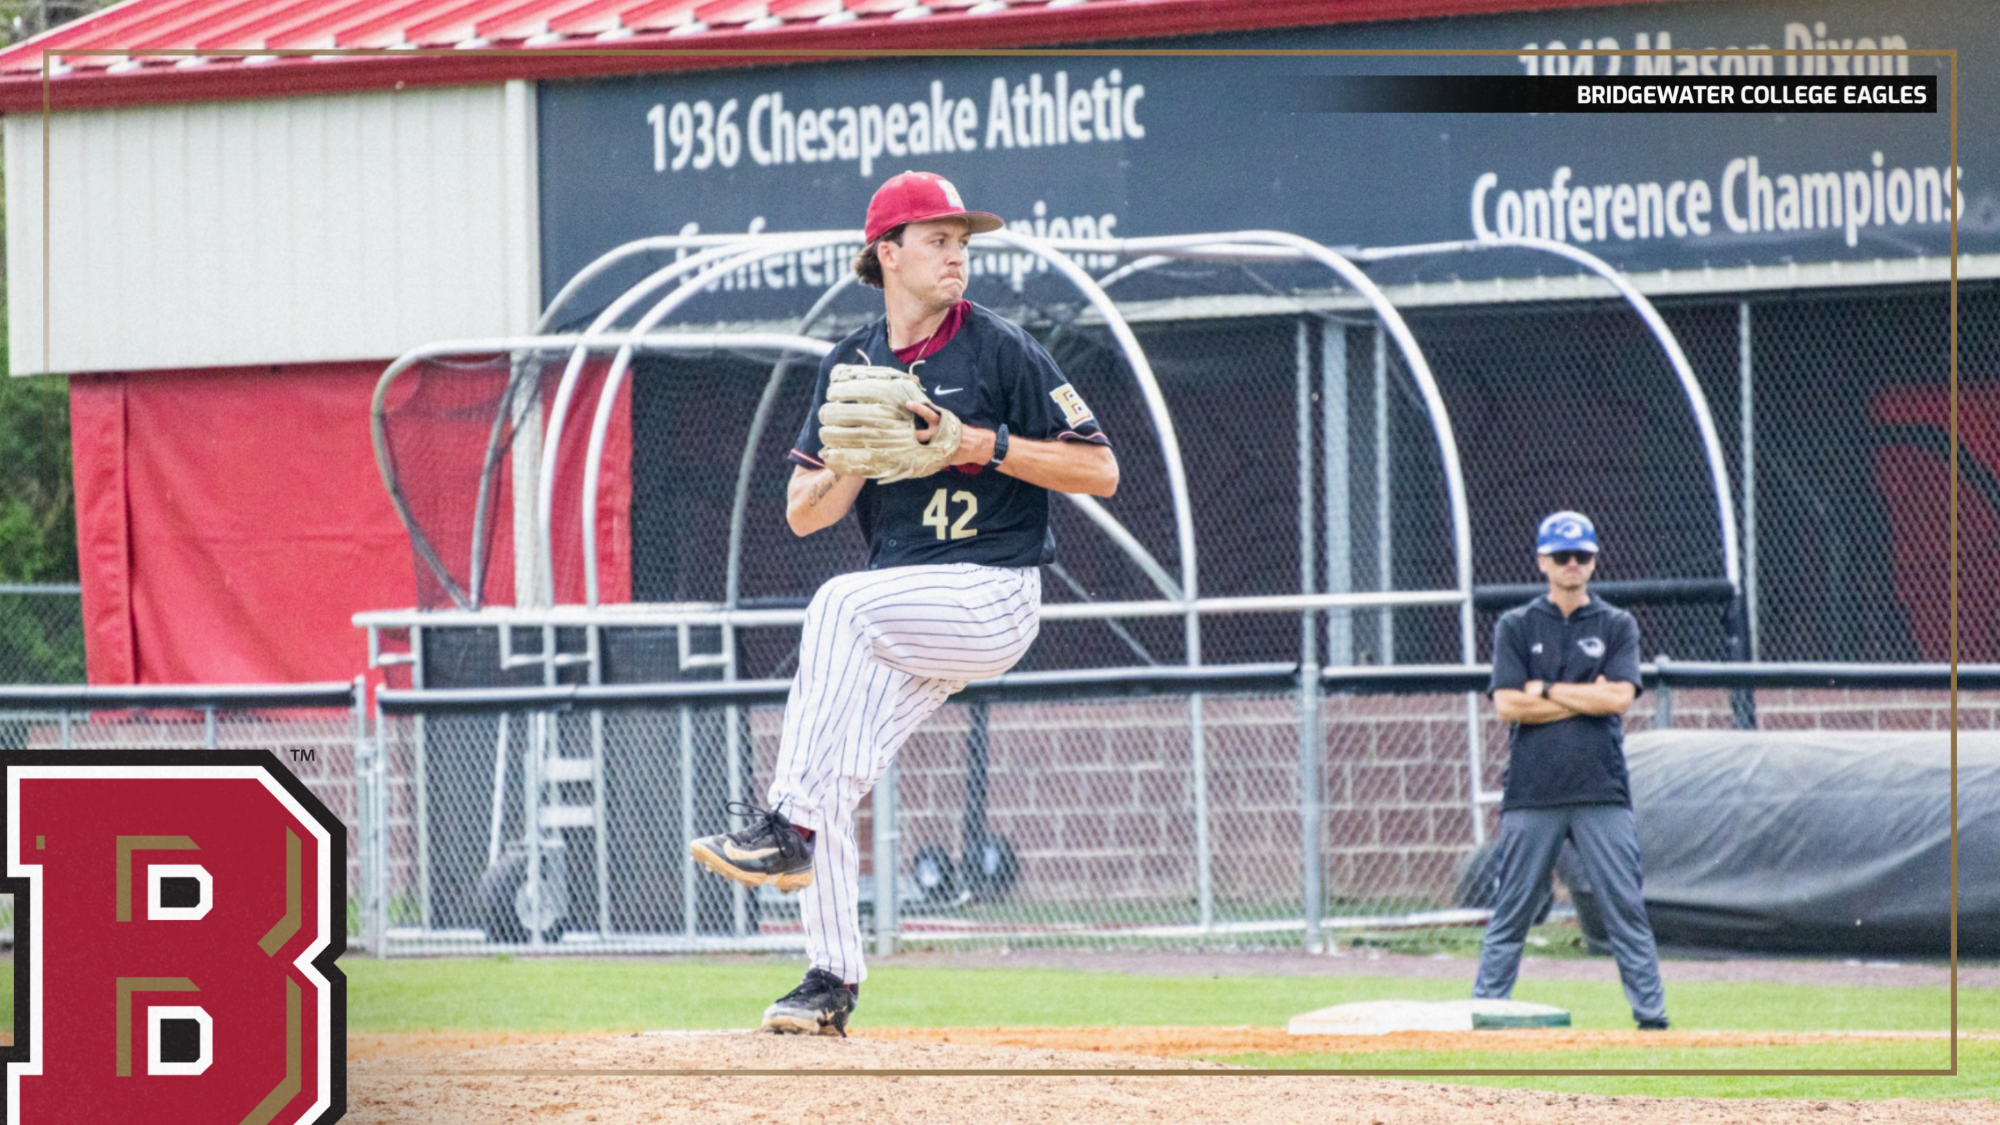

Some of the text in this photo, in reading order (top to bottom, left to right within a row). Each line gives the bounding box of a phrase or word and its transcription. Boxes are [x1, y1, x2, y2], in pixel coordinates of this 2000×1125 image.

[646, 68, 1146, 178] 1936 Chesapeake Athletic
[1470, 151, 1965, 247] Conference Champions
[922, 488, 979, 541] 42
